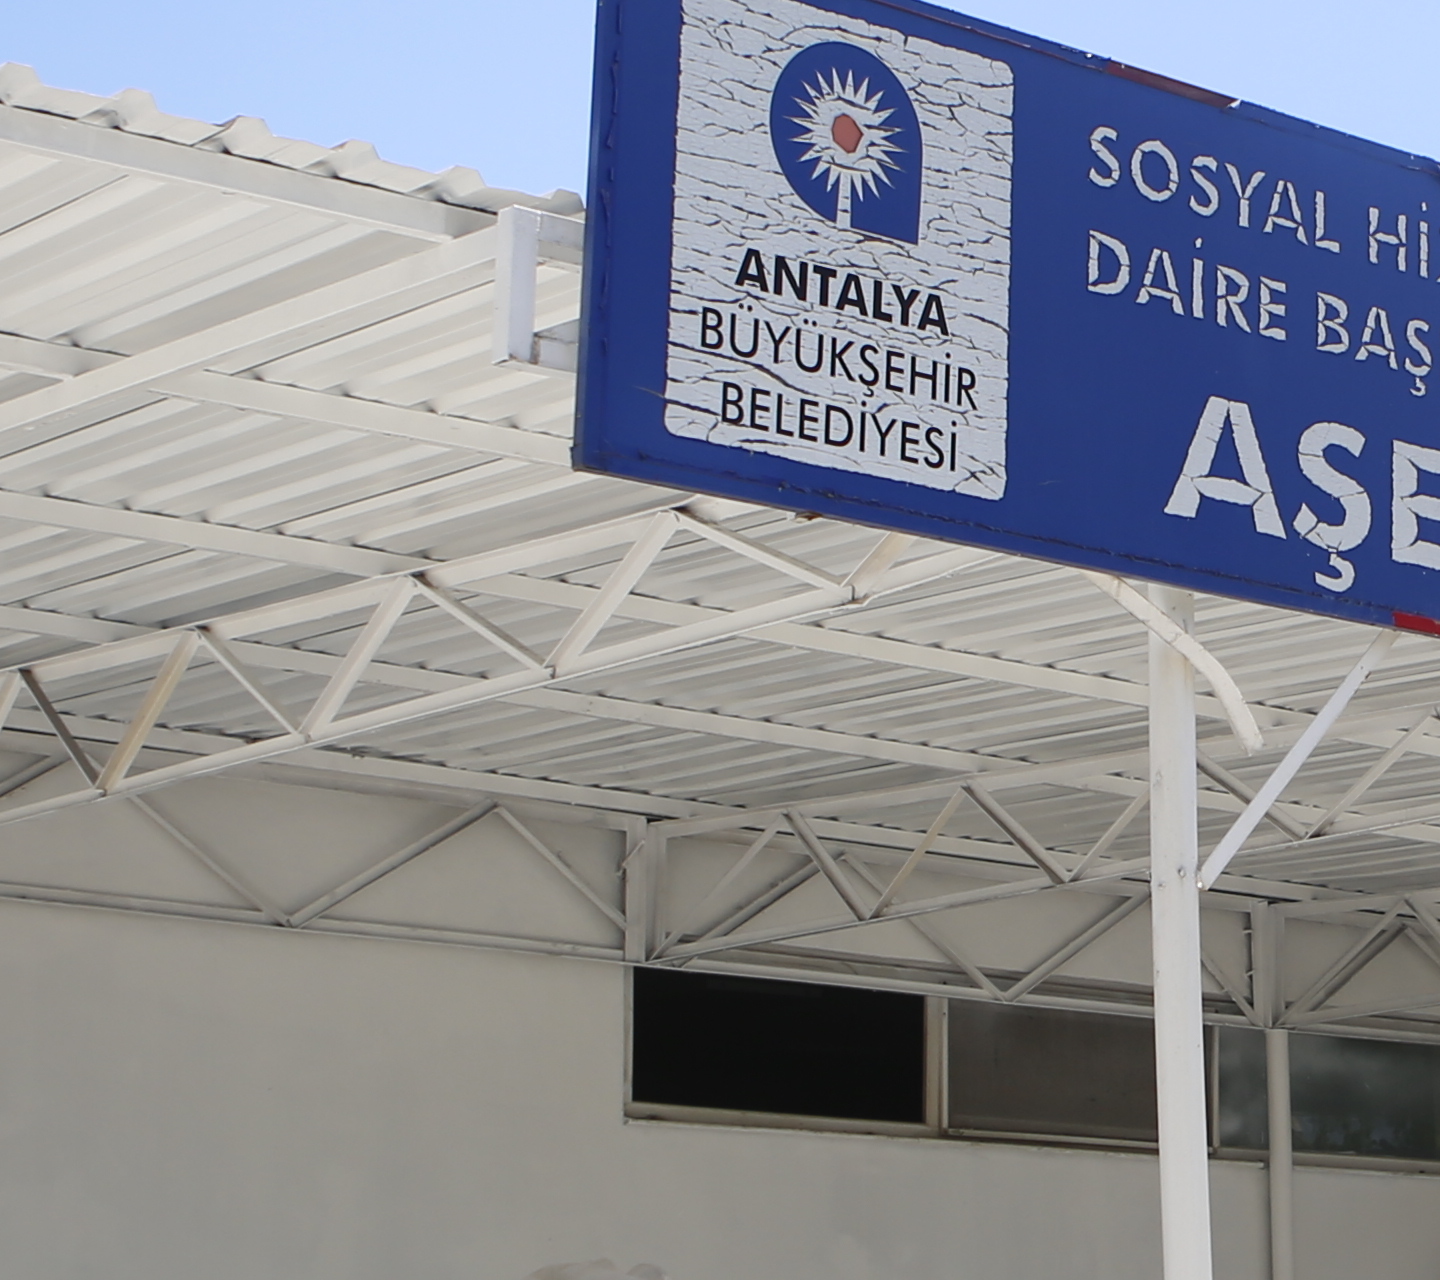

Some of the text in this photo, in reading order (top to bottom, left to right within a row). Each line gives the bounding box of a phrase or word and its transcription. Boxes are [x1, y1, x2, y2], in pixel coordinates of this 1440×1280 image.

[1087, 125, 1341, 254] SOSYAL
[734, 247, 950, 337] ANTALYA
[1086, 229, 1288, 342] DAİRE
[700, 302, 978, 411] BÜYÜKŞEHİR
[720, 381, 958, 472] BELEDİYESİ
